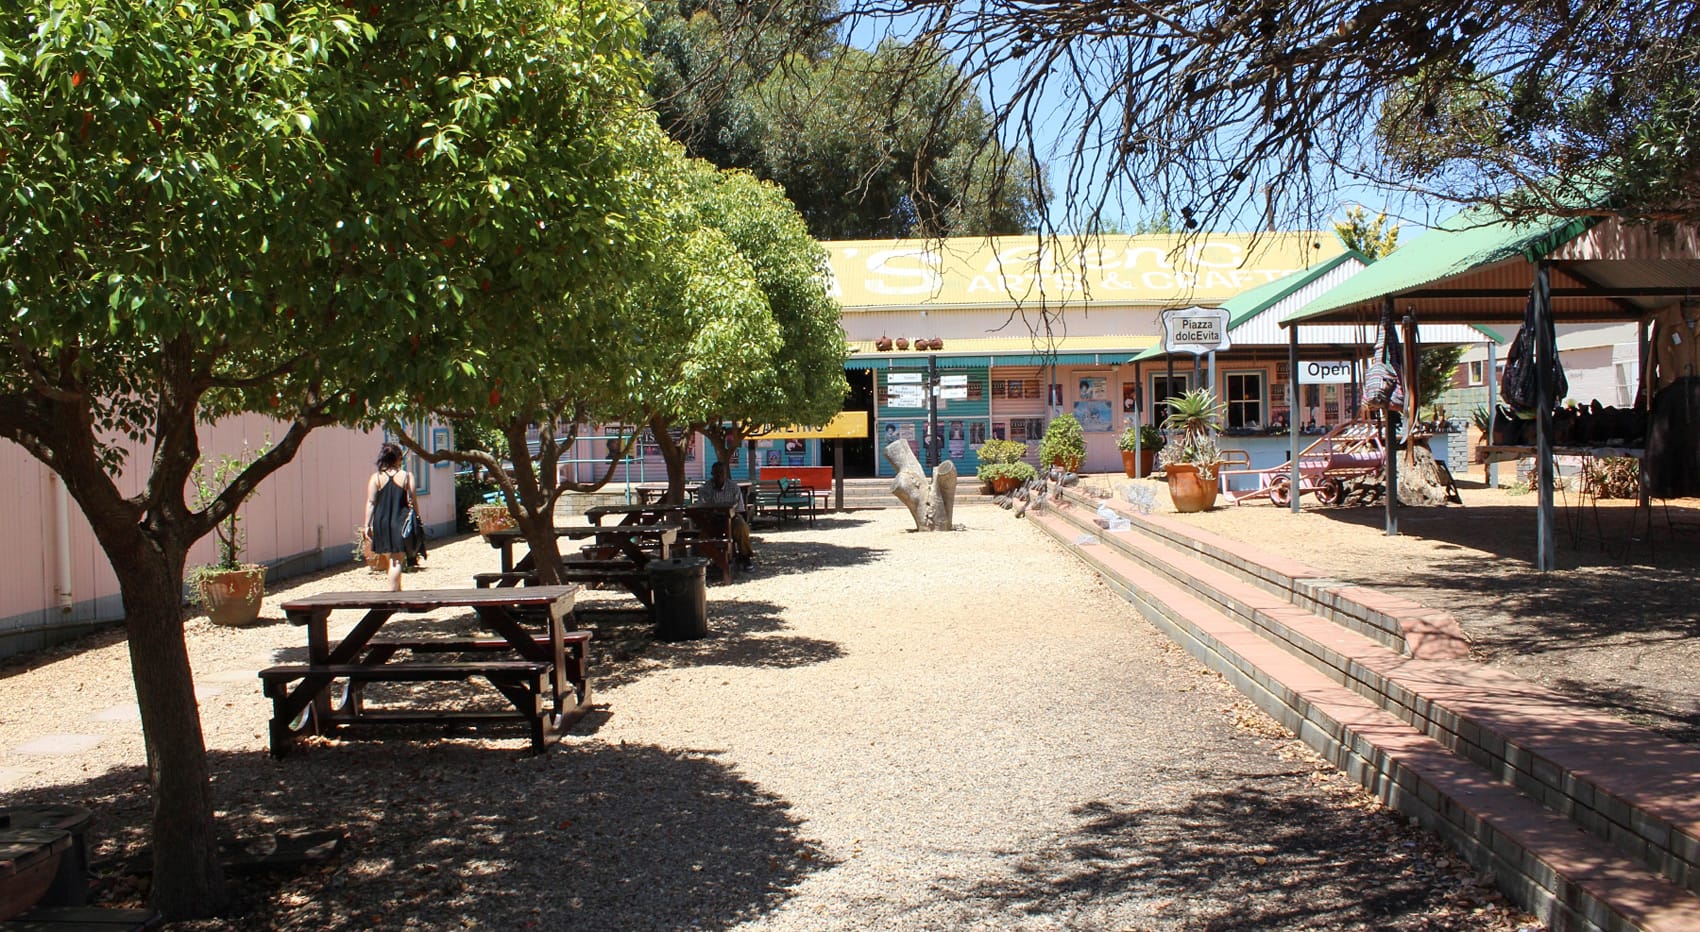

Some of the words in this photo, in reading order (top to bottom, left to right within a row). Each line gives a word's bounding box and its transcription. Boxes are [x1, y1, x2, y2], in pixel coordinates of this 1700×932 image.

[966, 271, 1082, 294] ARTS
[1100, 270, 1132, 292] &
[1181, 319, 1213, 330] Piazza
[1175, 329, 1219, 342] dolcEvita
[1307, 362, 1351, 380] Open
